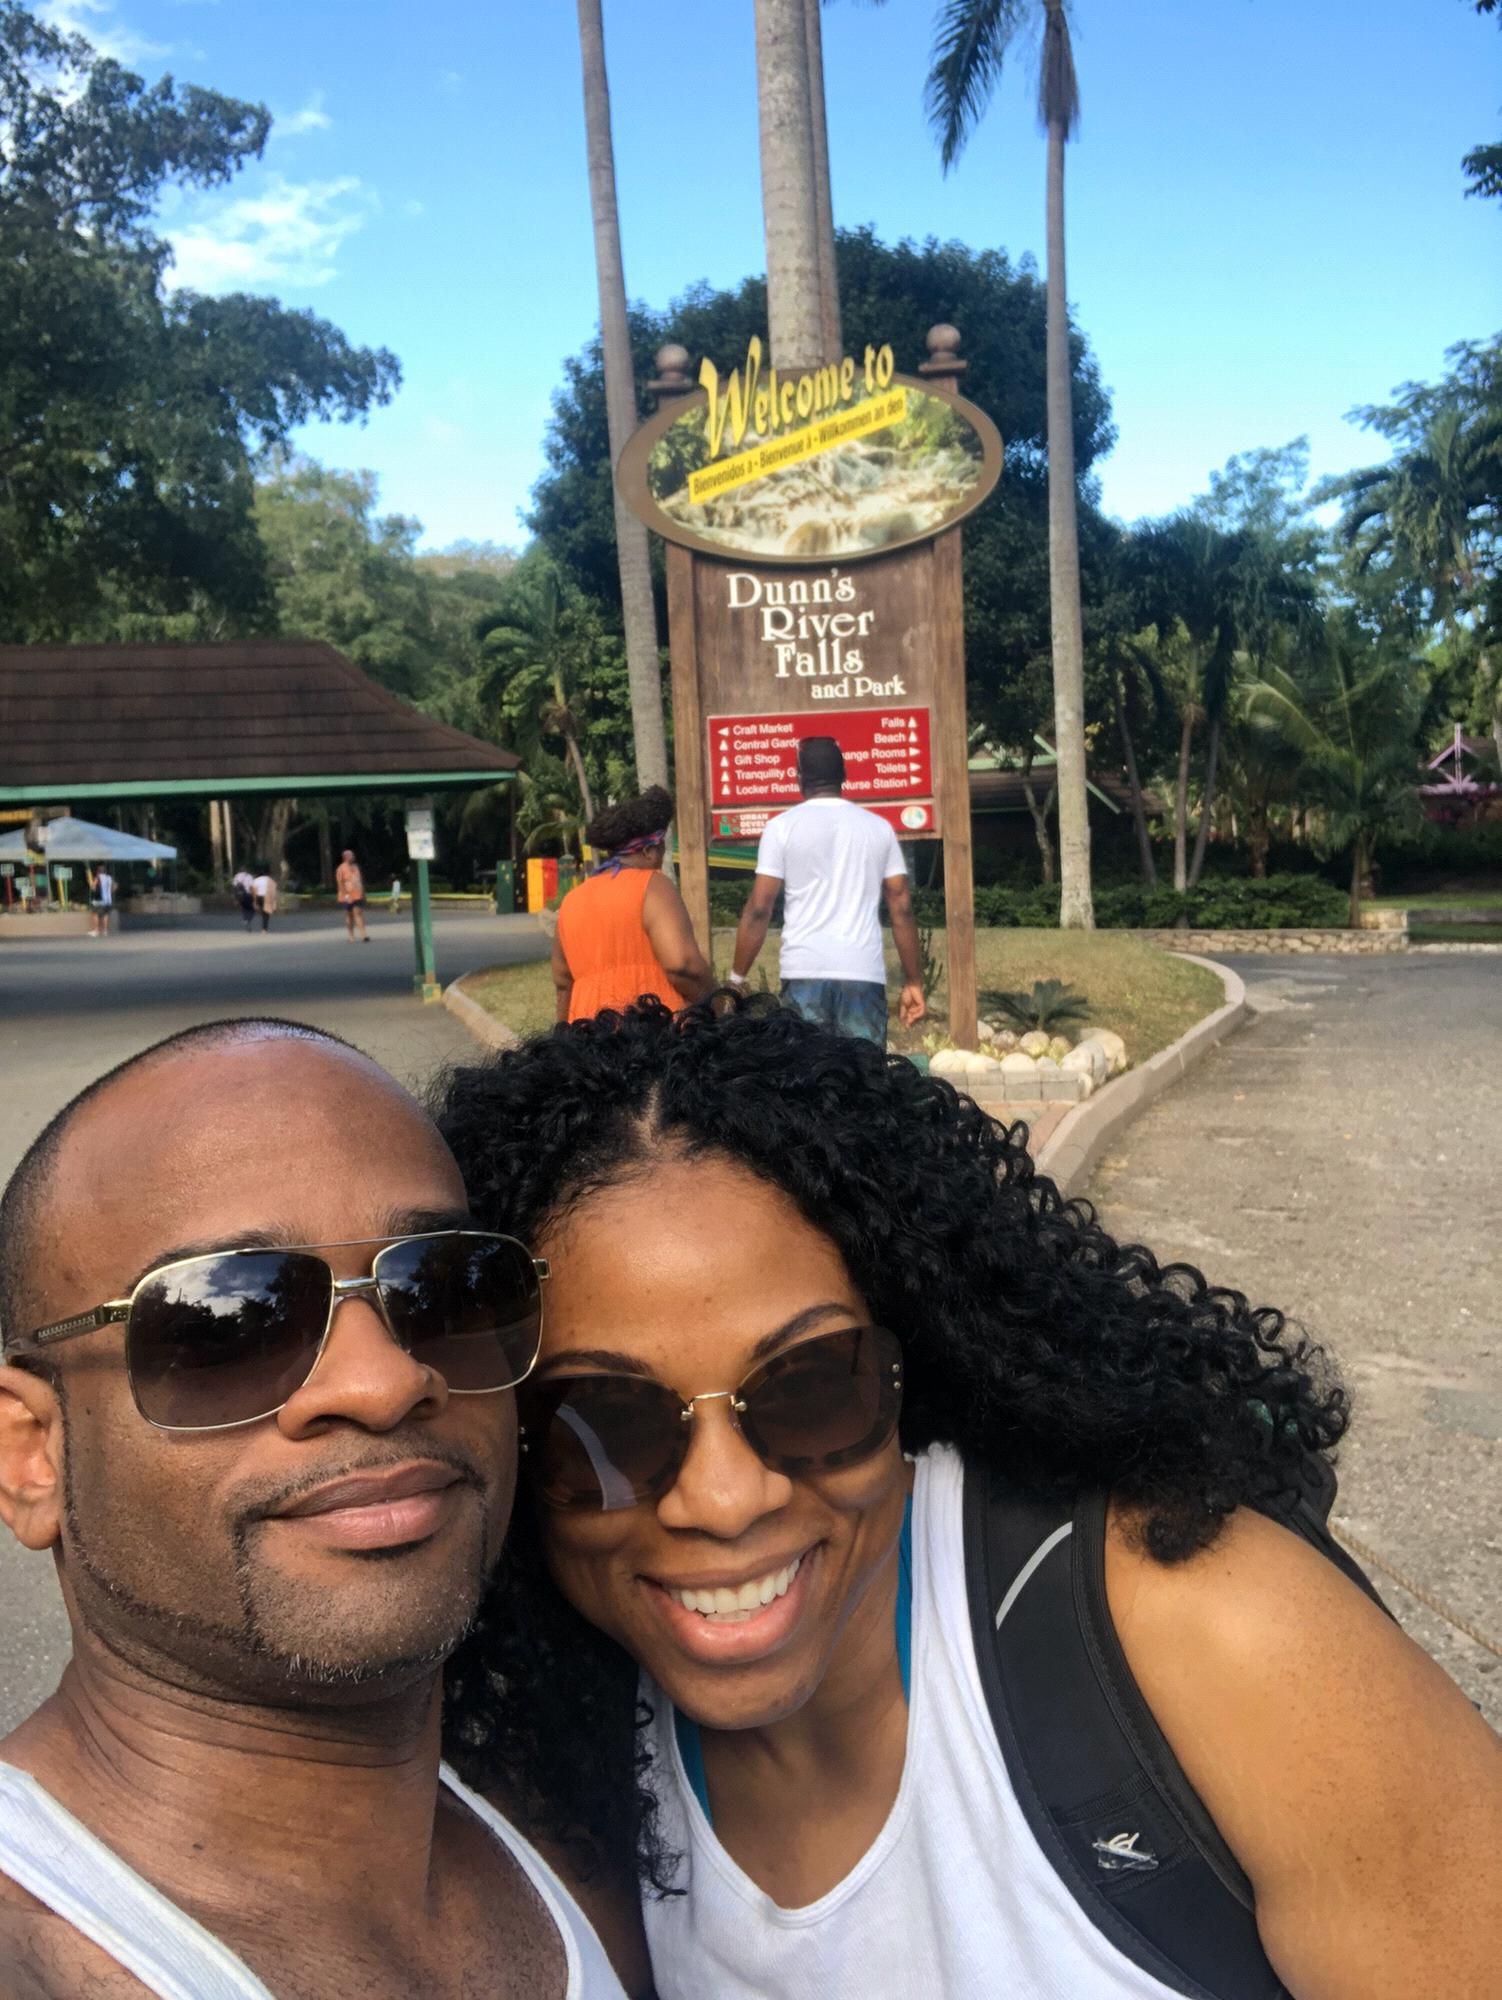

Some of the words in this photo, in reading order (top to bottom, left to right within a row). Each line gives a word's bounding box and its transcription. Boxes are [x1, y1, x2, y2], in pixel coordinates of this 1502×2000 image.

[699, 334, 855, 459] Welcome
[864, 343, 895, 393] to
[726, 568, 856, 608] Dunn's
[760, 606, 875, 641] River
[774, 638, 864, 678] Falls
[811, 676, 850, 699] and
[854, 674, 907, 698] Park
[732, 725, 758, 736] Craft
[759, 723, 794, 734] Market
[880, 717, 906, 729] Falls
[873, 732, 906, 744] Beach
[733, 739, 769, 751] Central
[734, 754, 753, 766] Gift
[754, 754, 781, 766] Shop
[842, 750, 869, 762] ange
[871, 747, 906, 759] Rooms
[874, 762, 907, 774] Toilets
[735, 784, 769, 796] Locker
[841, 780, 870, 791] Nurse
[873, 777, 907, 790] Station
